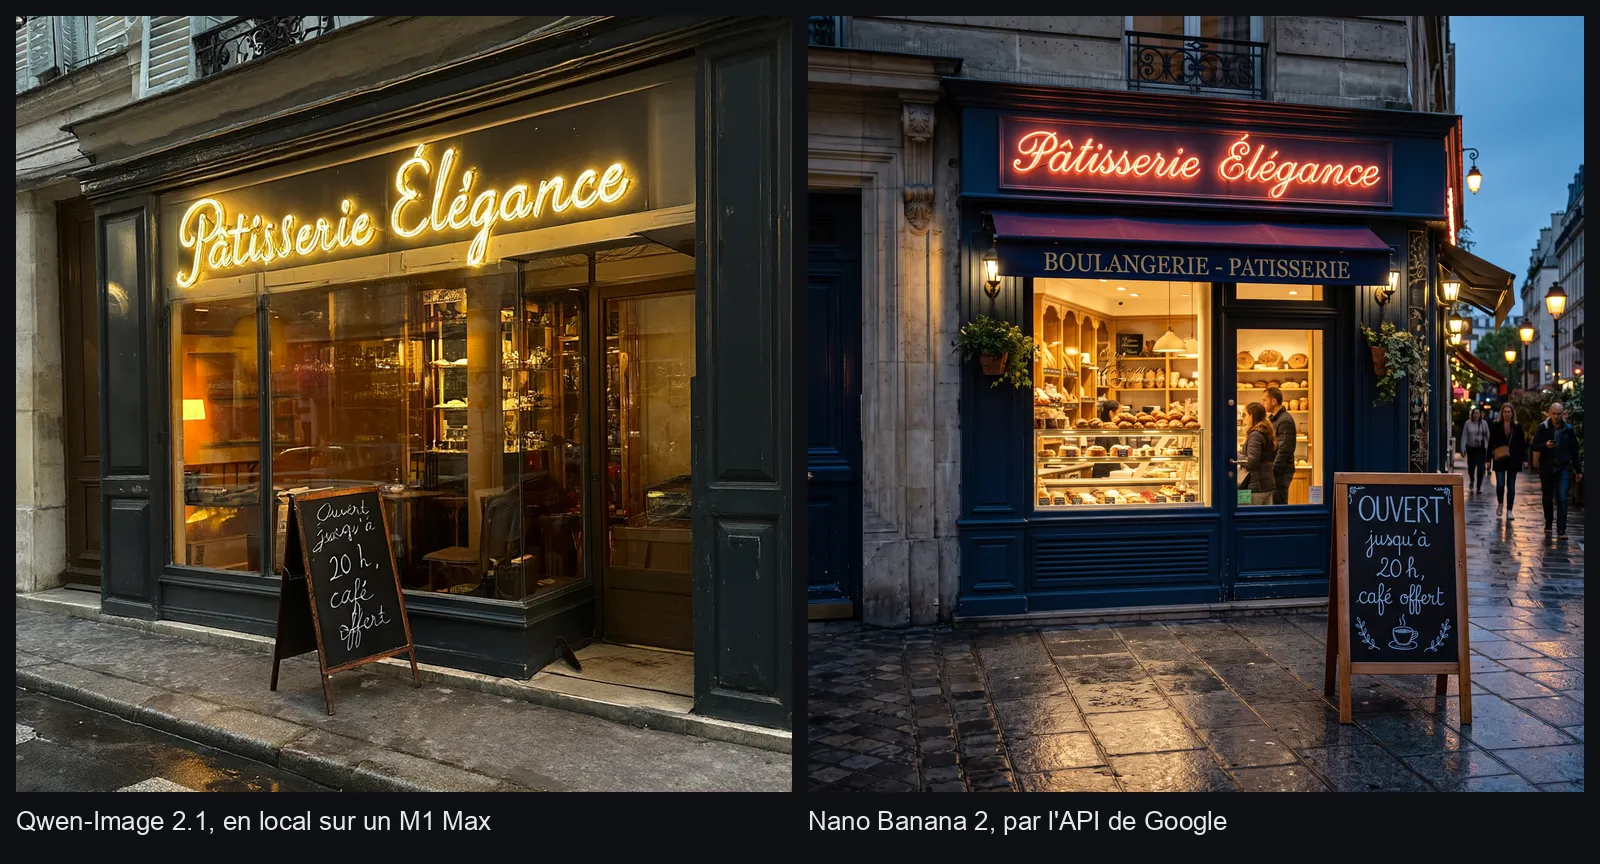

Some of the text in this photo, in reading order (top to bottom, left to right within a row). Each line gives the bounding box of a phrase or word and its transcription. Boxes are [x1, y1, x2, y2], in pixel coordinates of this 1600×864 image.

[1012, 130, 1382, 199] Pâtisserie Élégance
[176, 143, 630, 288] Pâtisserie Élégance
[1043, 251, 1210, 276] BOULANGERIE
[1228, 256, 1351, 279] PATISSERIE
[316, 499, 370, 522] Ouvert
[1358, 495, 1444, 524] OUVERT
[1365, 528, 1431, 558] jusqu'à
[329, 553, 352, 582] 20
[1376, 556, 1425, 581] 20 h,
[330, 577, 375, 613] café
[1356, 582, 1445, 616] café offert
